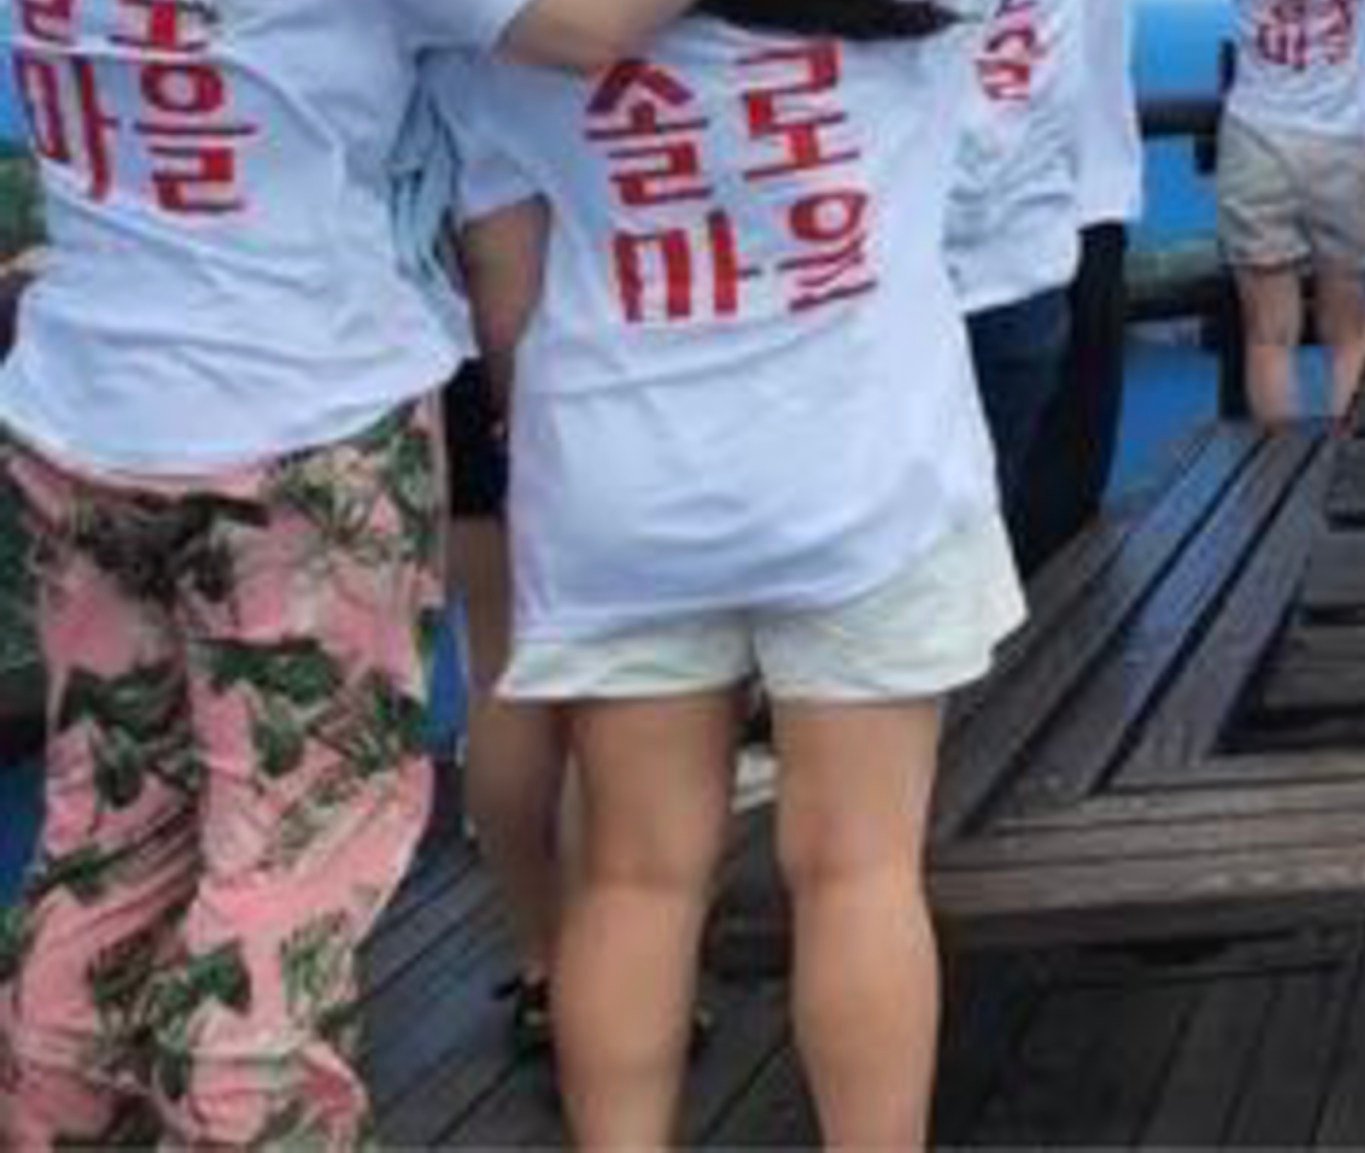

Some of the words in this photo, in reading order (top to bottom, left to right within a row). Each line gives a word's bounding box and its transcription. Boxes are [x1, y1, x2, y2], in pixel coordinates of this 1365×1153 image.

[12, 51, 259, 217] 마을
[583, 36, 862, 208] 솔로
[608, 188, 880, 325] 마을
